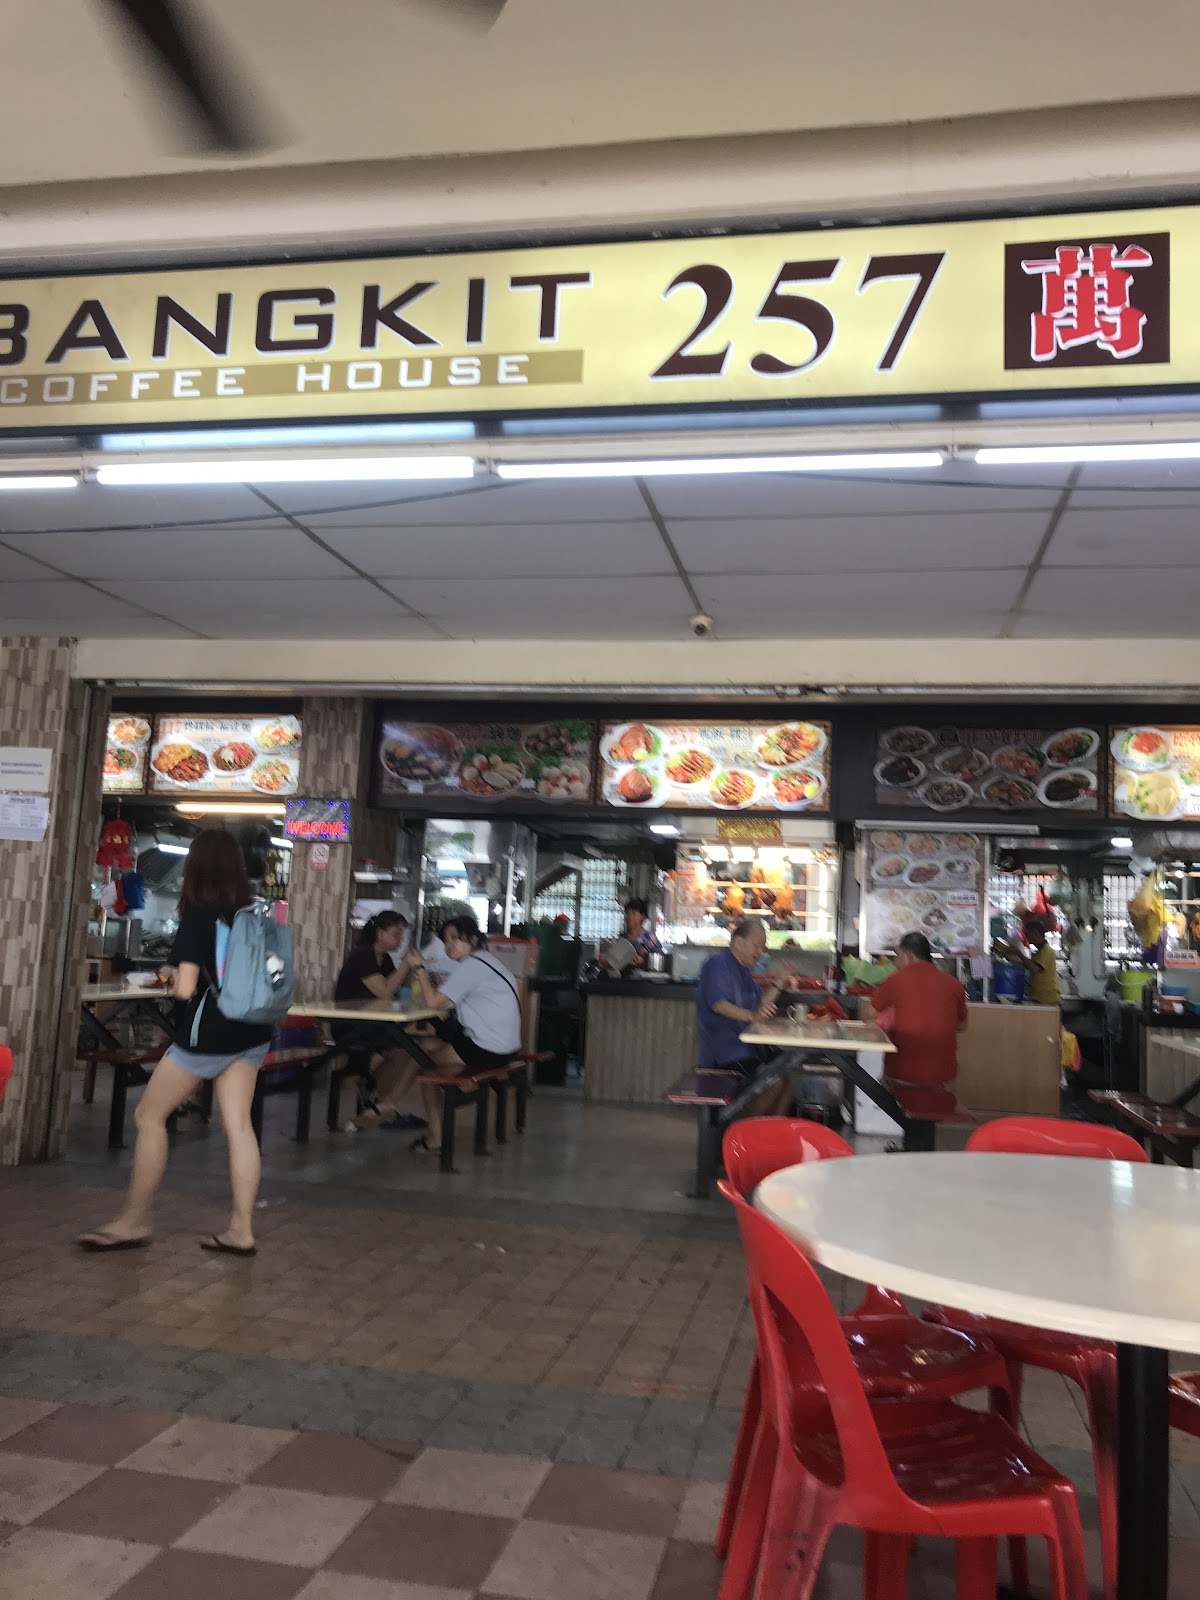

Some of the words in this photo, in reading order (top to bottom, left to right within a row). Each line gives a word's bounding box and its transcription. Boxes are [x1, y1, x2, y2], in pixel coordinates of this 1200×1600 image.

[649, 250, 949, 381] 257
[1020, 243, 1154, 363] 萬
[0, 367, 246, 404] COFFEE
[296, 354, 531, 393] HOUSE
[287, 820, 346, 836] WELCOME
